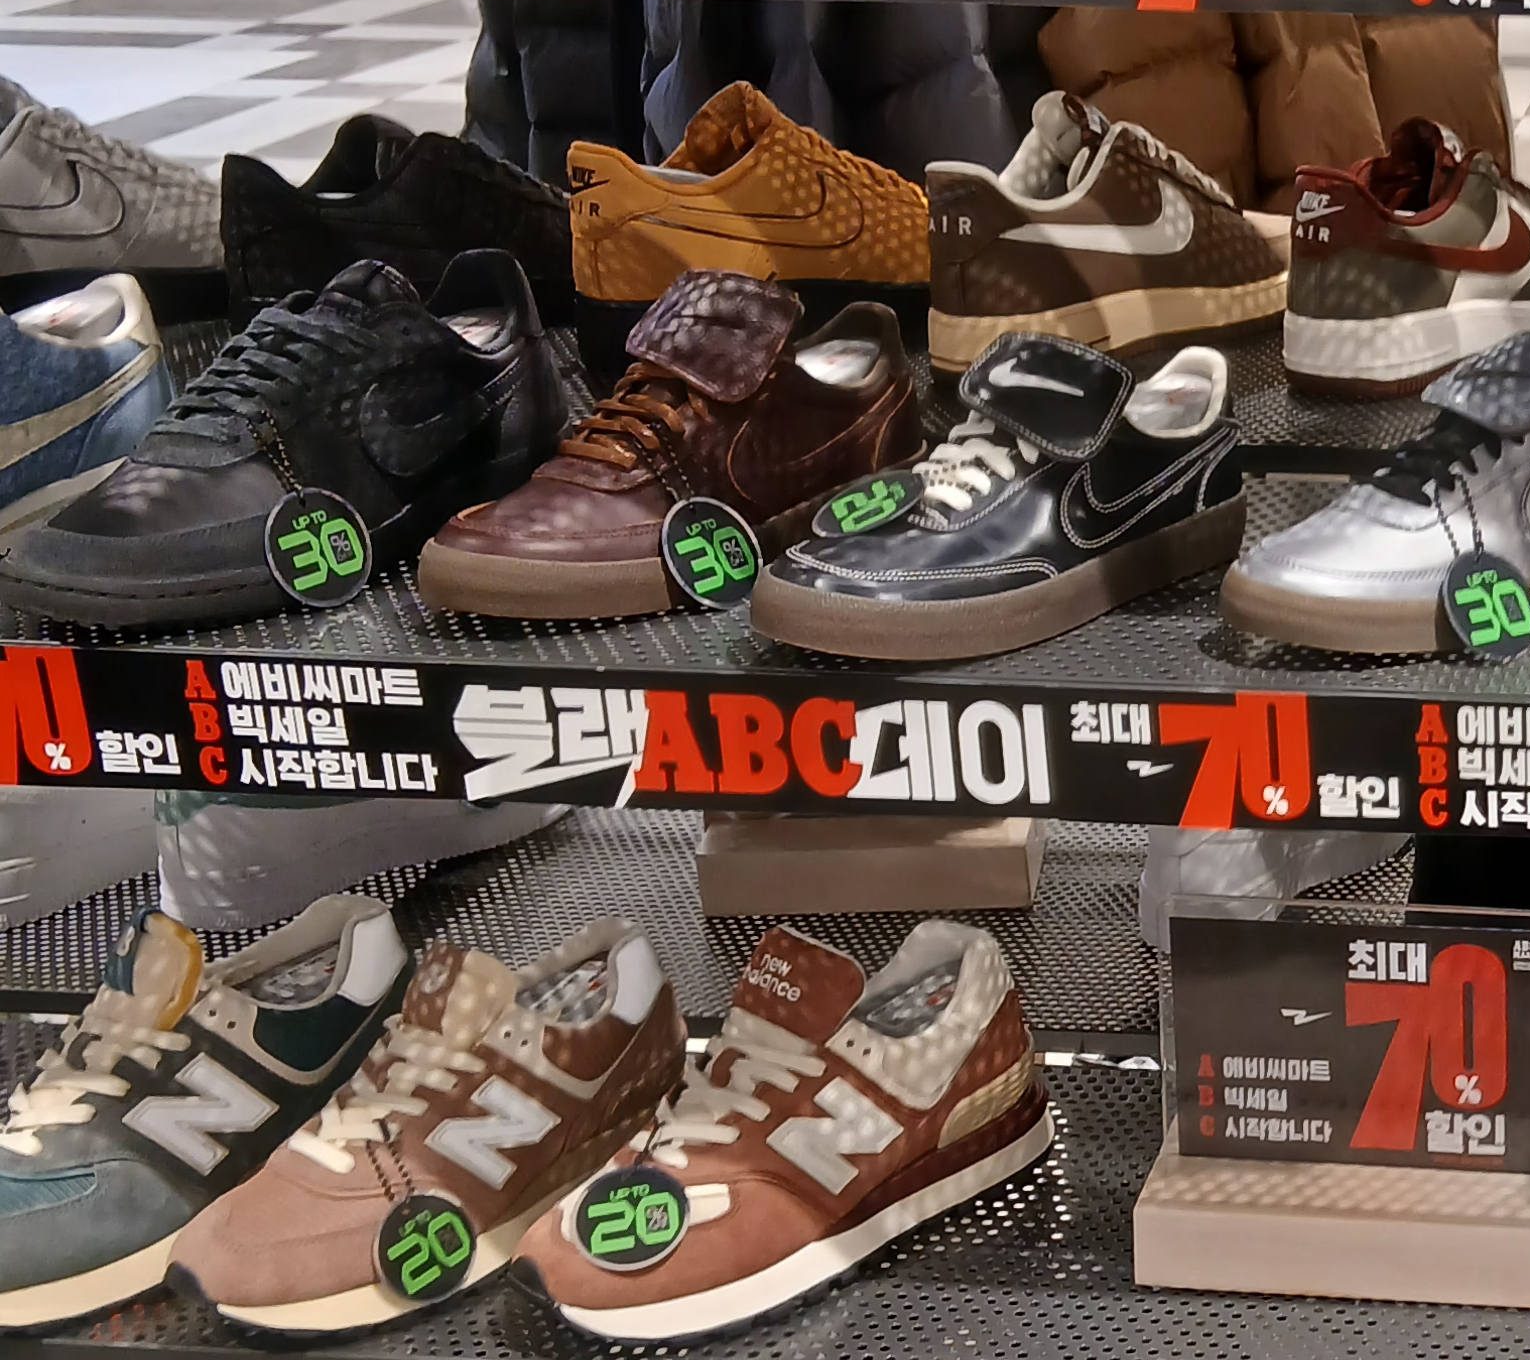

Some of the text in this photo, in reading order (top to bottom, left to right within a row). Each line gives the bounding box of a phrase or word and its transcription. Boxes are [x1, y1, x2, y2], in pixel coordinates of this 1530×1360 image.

[1295, 223, 1331, 244] AIR
[291, 509, 328, 531] UP TO
[685, 517, 717, 537] UP TO
[184, 660, 425, 707] A 에비씨마트
[188, 703, 350, 747] B 빅세일
[1415, 704, 1448, 745] A
[94, 731, 182, 776] 할인
[199, 746, 439, 794] C 시작합니다
[1070, 700, 1152, 746] 최대
[1316, 773, 1400, 819] 할인
[1417, 745, 1448, 786] B
[1419, 788, 1449, 828] C
[761, 953, 793, 977] new
[1347, 938, 1428, 984] 최대
[1222, 1056, 1332, 1083] 에비씨마트
[1223, 1086, 1289, 1113] 빅세일
[1224, 1115, 1333, 1145] 시작합니다
[1424, 1109, 1508, 1157] 할인
